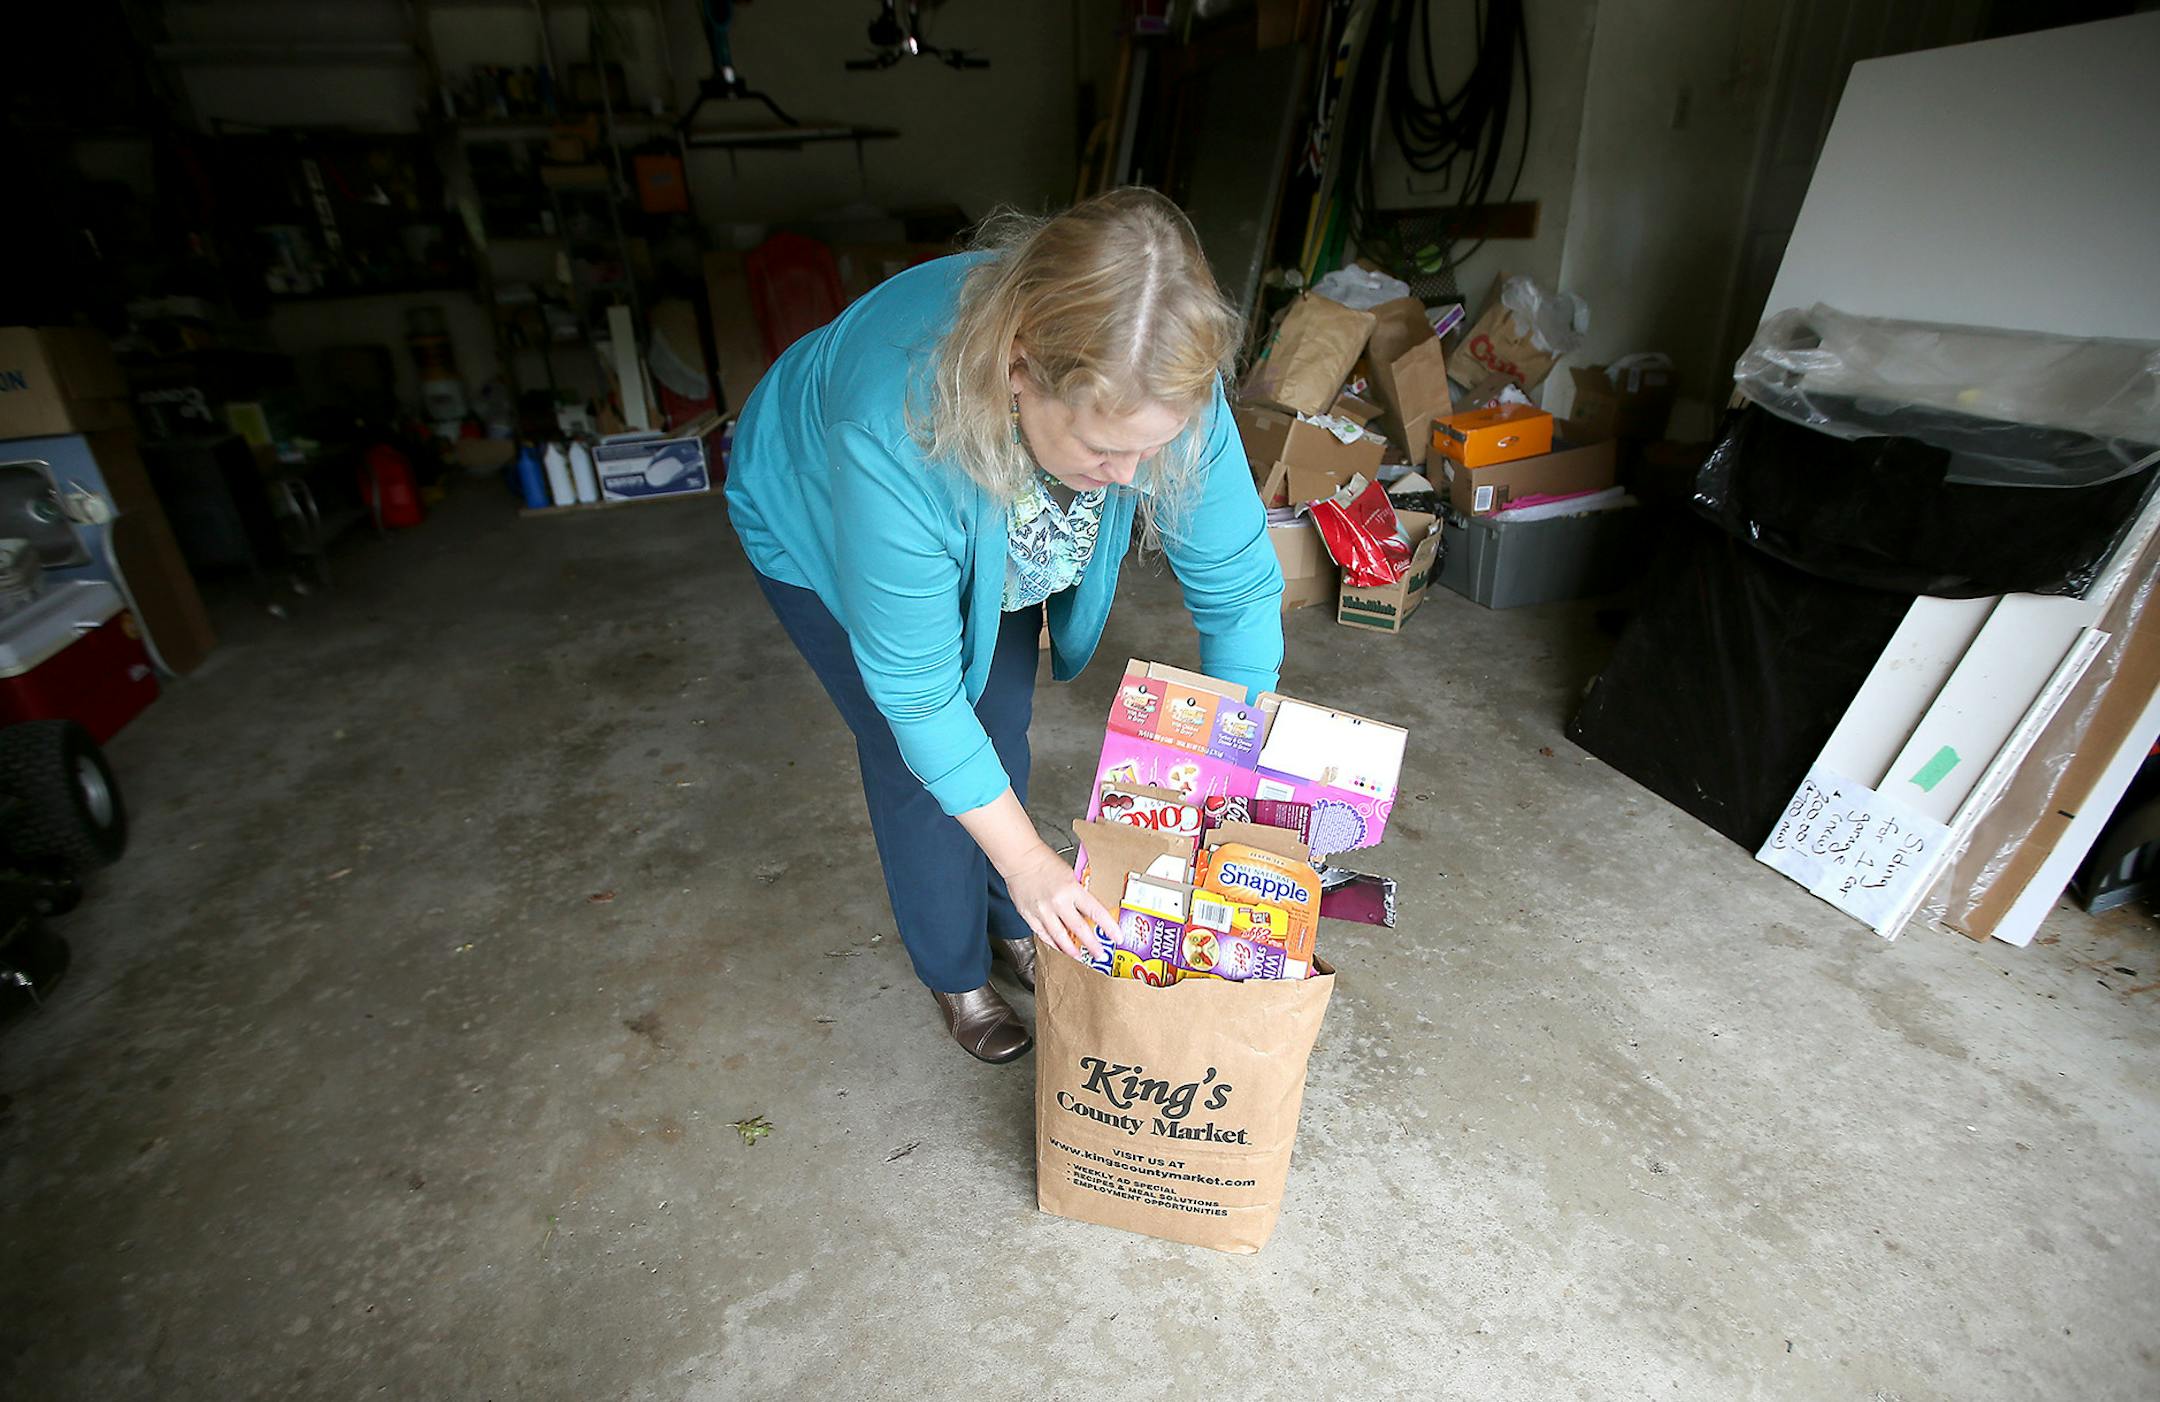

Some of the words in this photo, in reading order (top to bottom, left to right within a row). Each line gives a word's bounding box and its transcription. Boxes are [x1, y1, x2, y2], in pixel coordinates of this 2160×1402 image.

[1829, 810, 1871, 865] garage
[1875, 817, 1899, 843] for
[1860, 833, 1924, 888] Siding
[1220, 862, 1308, 902] Snapple
[1839, 875, 1857, 898] car
[1162, 927, 1176, 959] WIN
[1080, 1057, 1233, 1119] King's
[1057, 1091, 1144, 1135] County
[1150, 1117, 1248, 1145] Market
[1049, 1136, 1255, 1187] www.kingscountymarket.com
[1112, 1148, 1145, 1163] VISIT
[1147, 1157, 1165, 1167] US
[1168, 1160, 1185, 1169] AT
[1073, 1163, 1114, 1180] WEEKLY
[1116, 1177, 1131, 1185] AD
[1134, 1181, 1177, 1195] SPECIAL
[1073, 1171, 1115, 1189] RECIPES
[1128, 1187, 1156, 1199] MEAL
[1159, 1193, 1219, 1208] SOLUTIONS
[1073, 1178, 1141, 1202] EMPLOYMENT
[1144, 1198, 1229, 1217] OPPORTUNITIES
